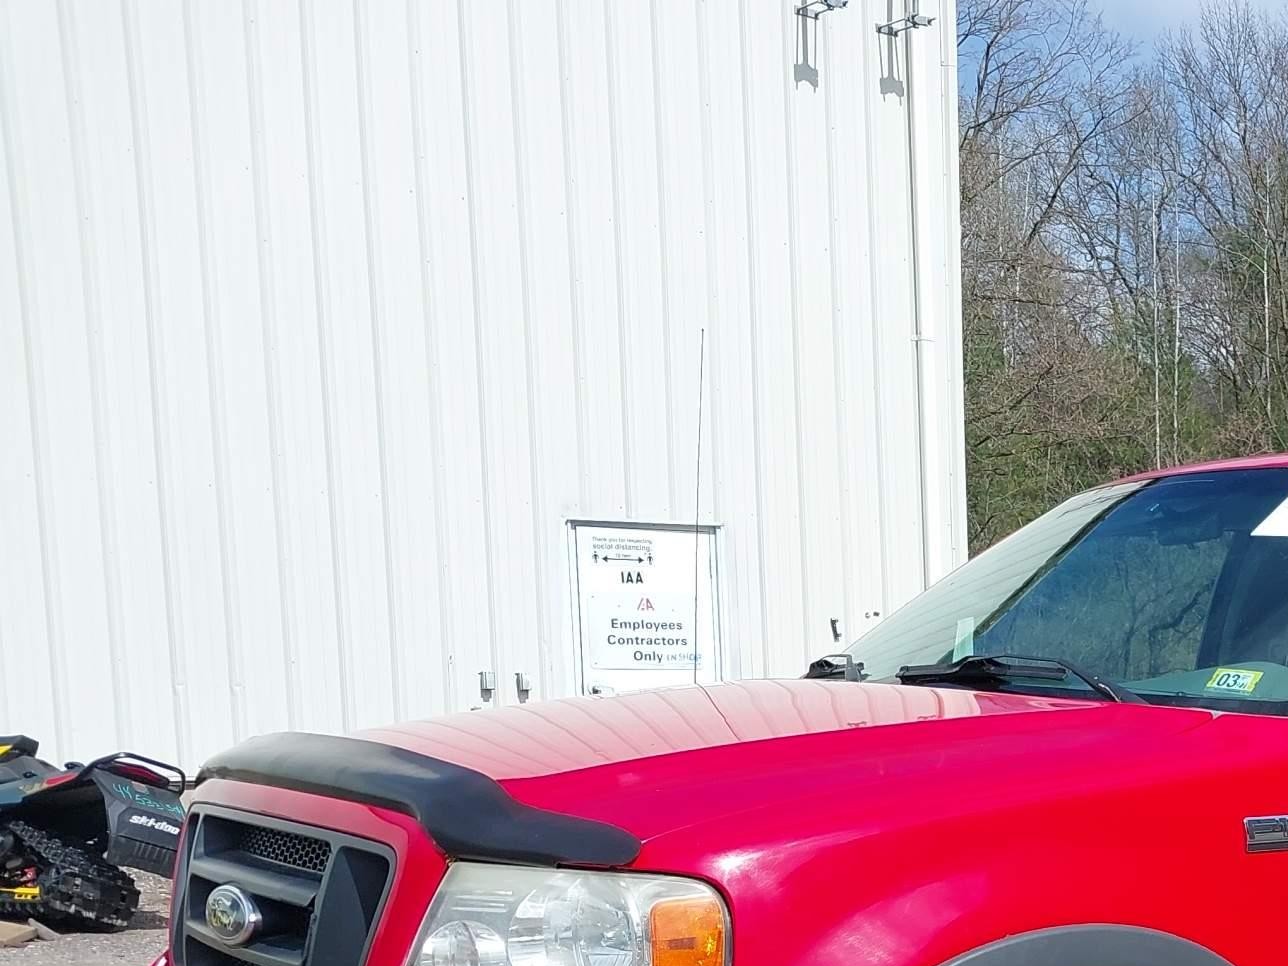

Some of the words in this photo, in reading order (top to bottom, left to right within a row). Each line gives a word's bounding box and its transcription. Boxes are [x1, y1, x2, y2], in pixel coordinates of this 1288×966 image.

[621, 571, 643, 584] IAA
[611, 618, 683, 632] Employees
[607, 635, 688, 645] Contractors
[633, 651, 663, 663] Only
[1217, 673, 1240, 688] 03
